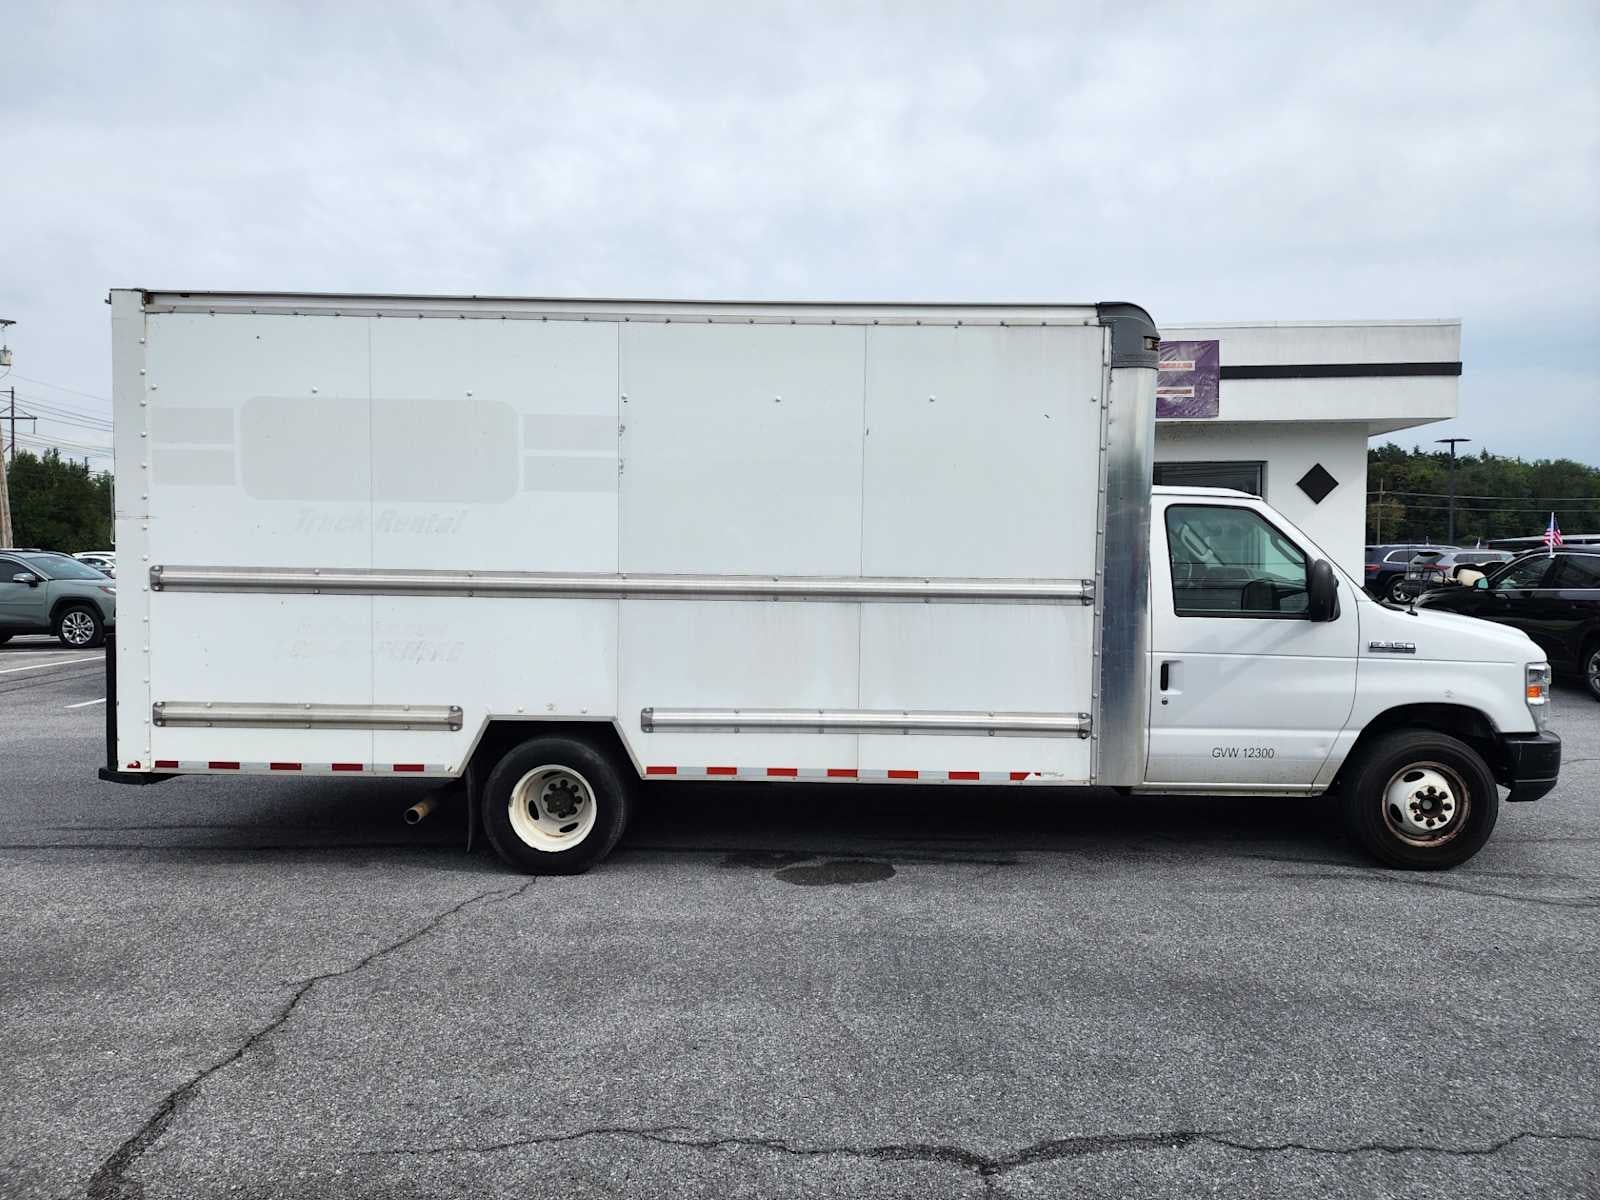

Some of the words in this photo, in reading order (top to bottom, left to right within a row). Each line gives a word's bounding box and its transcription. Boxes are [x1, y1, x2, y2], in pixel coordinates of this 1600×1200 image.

[295, 507, 371, 535] Truck
[376, 507, 470, 536] Rental
[1211, 747, 1239, 759] GVW
[1243, 747, 1275, 759] 12300
